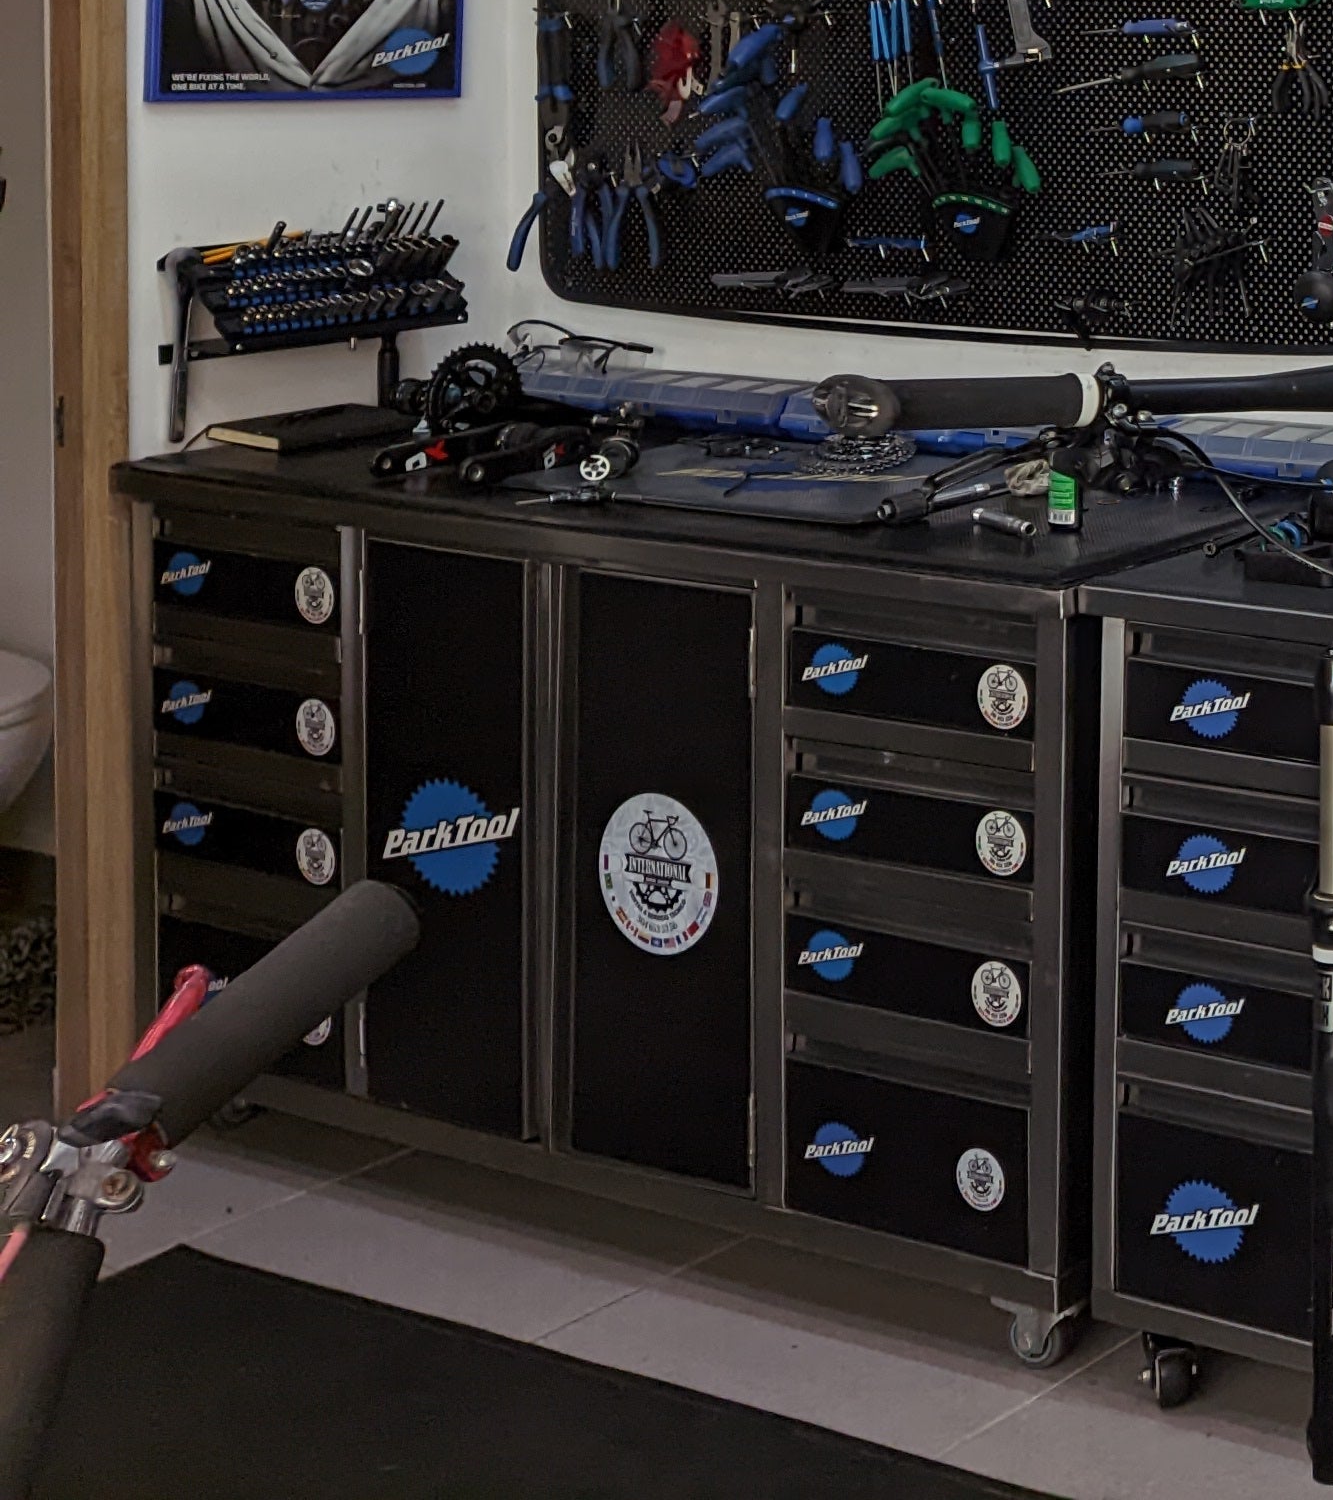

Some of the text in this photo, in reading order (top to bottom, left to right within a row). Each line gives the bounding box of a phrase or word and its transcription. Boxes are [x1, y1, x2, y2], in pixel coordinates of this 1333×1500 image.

[371, 33, 450, 68] ParkTool
[171, 82, 188, 91] ONE
[207, 82, 217, 91] AT
[217, 82, 225, 91] A
[225, 73, 240, 82] THE
[161, 560, 211, 585] ParkTool
[802, 654, 868, 681] ParkTool
[162, 690, 212, 714] ParkTool
[1169, 691, 1252, 723] ParkTool
[163, 811, 213, 834] ParkTool
[801, 800, 867, 827] ParkTool
[382, 807, 521, 861] ParkTool
[1166, 848, 1246, 877] ParkTool
[798, 943, 863, 966] ParkTool
[1165, 998, 1245, 1026] ParkTool
[804, 1137, 874, 1160] ParkTool
[1150, 1203, 1259, 1236] ParkTool
